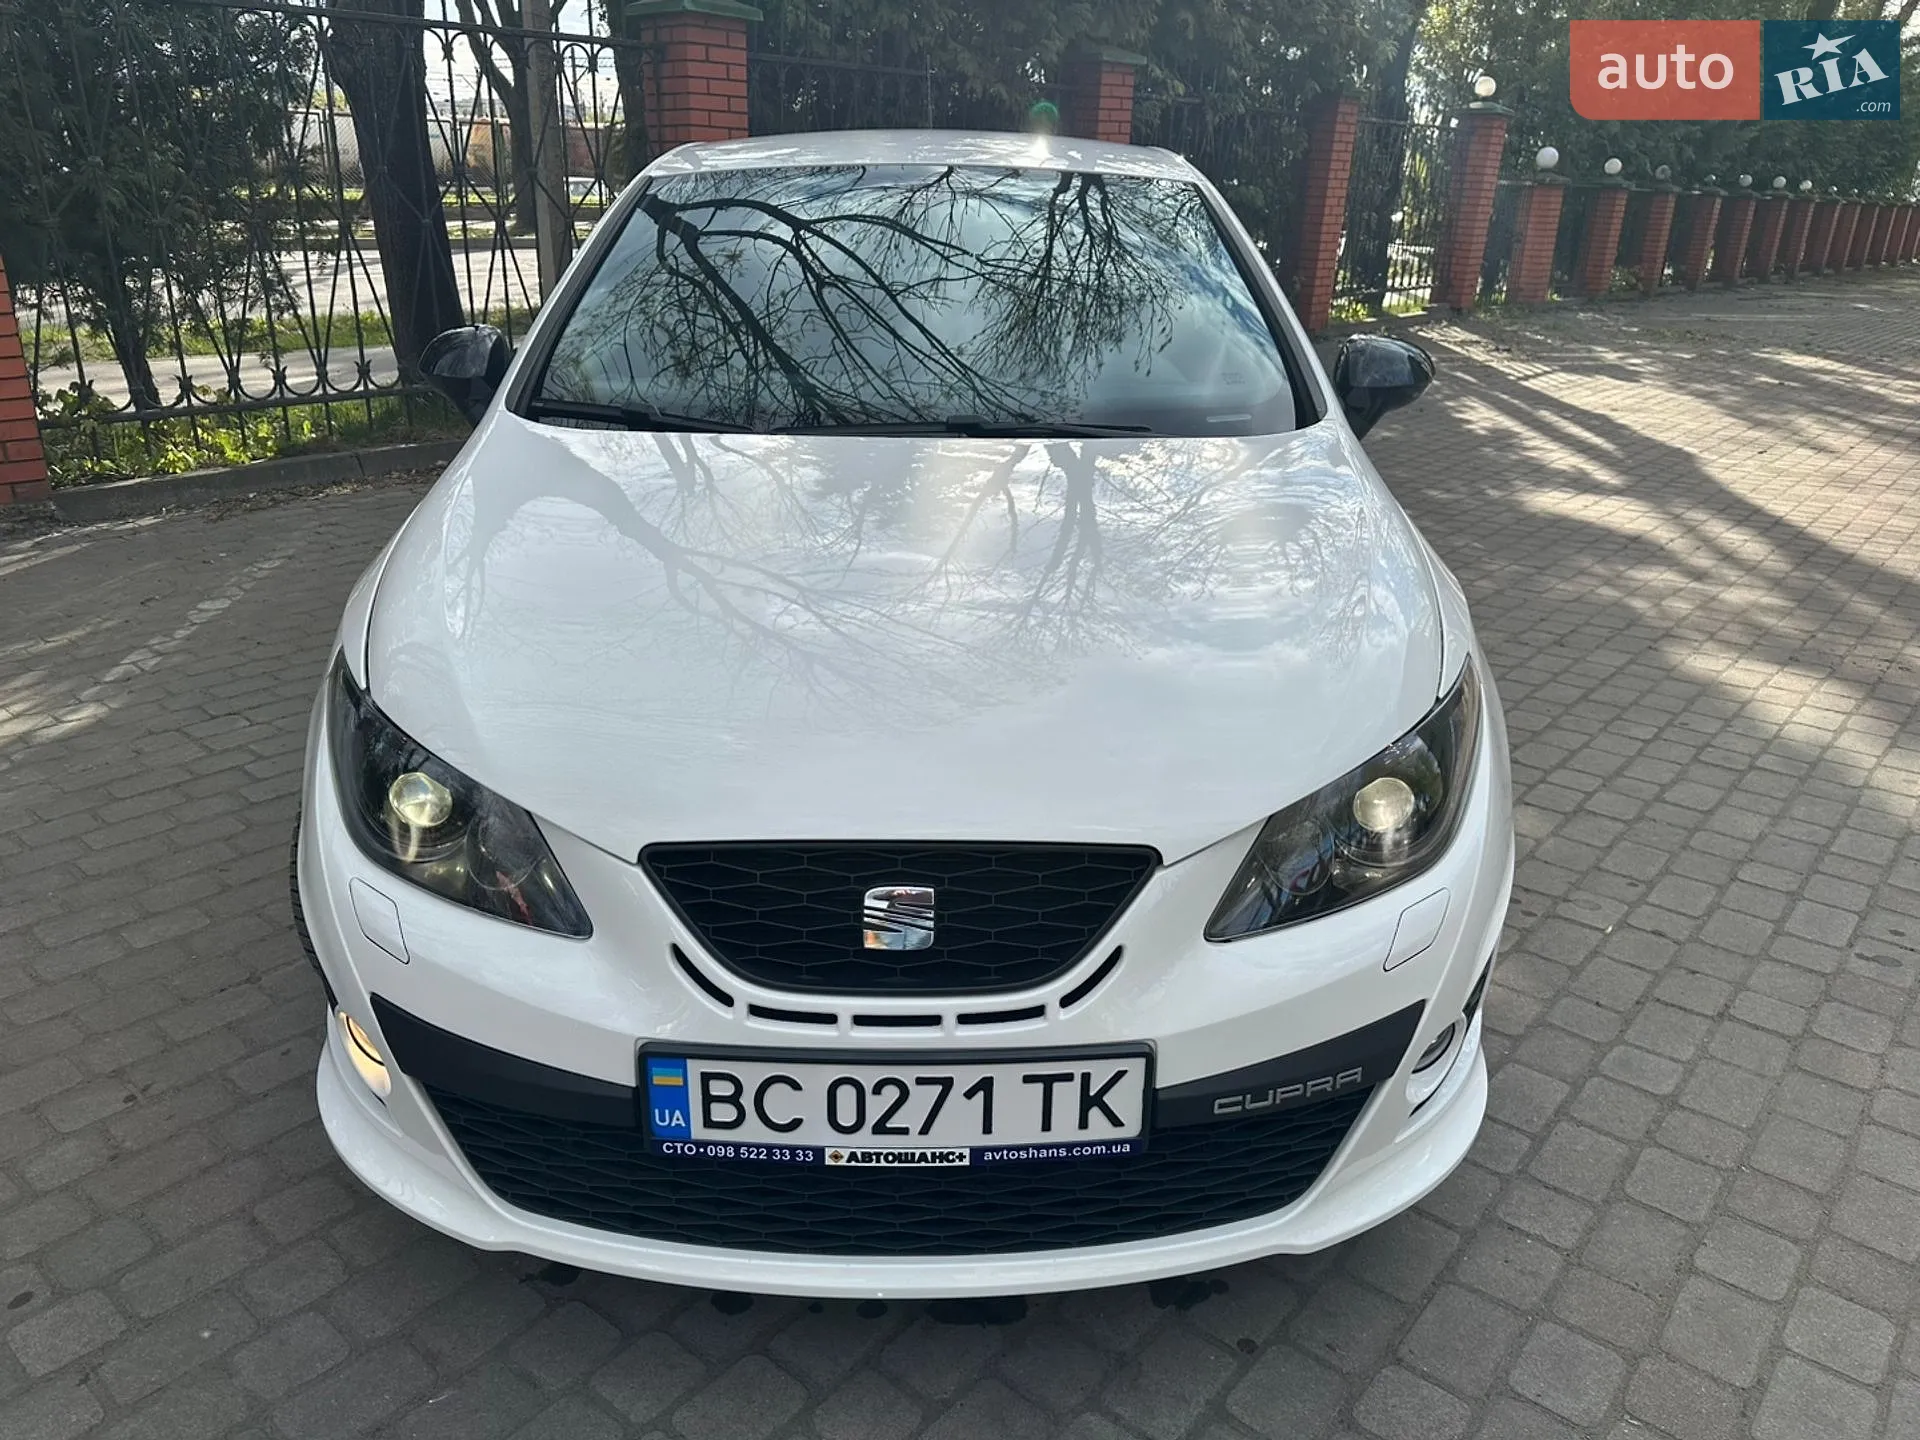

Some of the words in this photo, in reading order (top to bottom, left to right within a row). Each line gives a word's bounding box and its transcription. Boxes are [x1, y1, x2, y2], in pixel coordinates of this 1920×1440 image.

[1213, 1066, 1363, 1115] CUPRA
[700, 1071, 804, 1133] BC
[826, 1075, 994, 1136] 0271
[1022, 1069, 1129, 1132] TK
[655, 1109, 686, 1127] UA
[740, 1146, 767, 1160] 522
[772, 1148, 791, 1161] 33
[796, 1149, 814, 1162] 33
[983, 1143, 1131, 1161] avtoshans.com.ua
